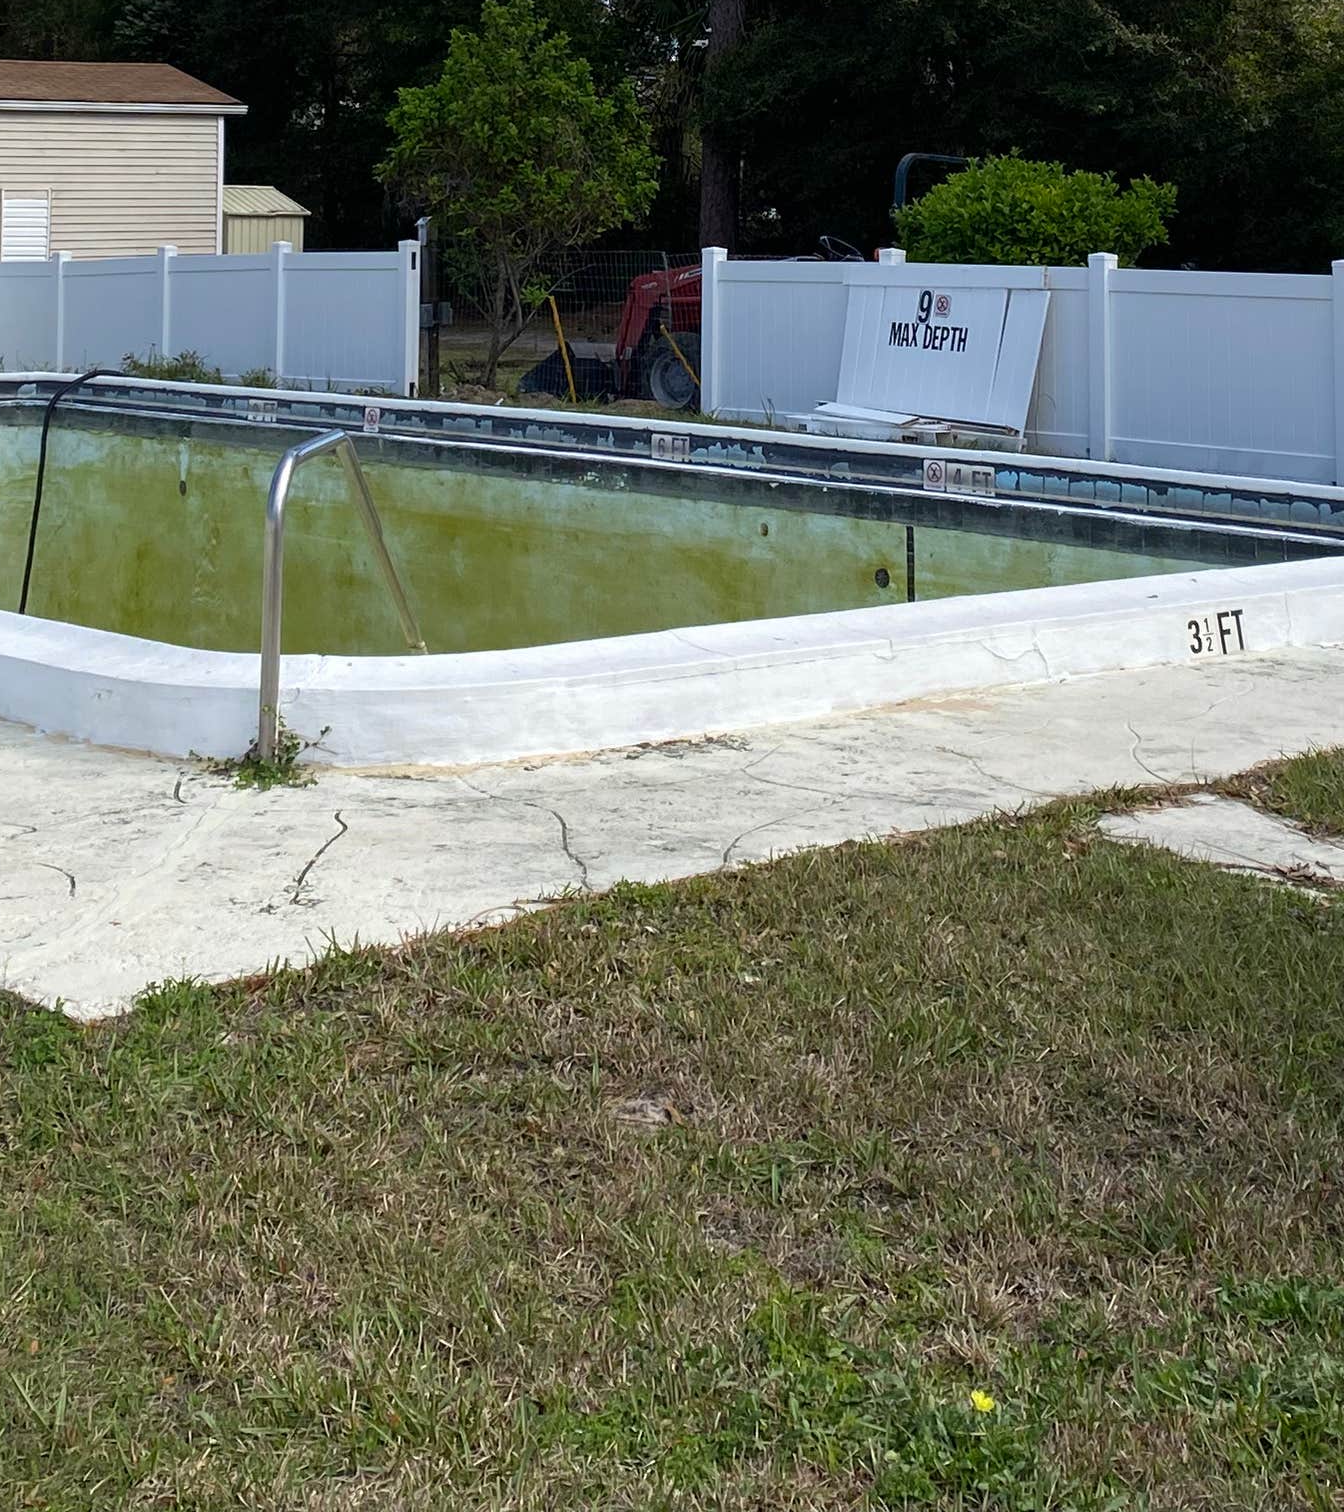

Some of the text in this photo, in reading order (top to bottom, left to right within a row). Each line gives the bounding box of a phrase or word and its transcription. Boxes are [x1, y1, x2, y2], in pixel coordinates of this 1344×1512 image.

[918, 290, 933, 323] 9
[888, 322, 968, 352] MAX DEPTH
[1216, 609, 1245, 655] FT
